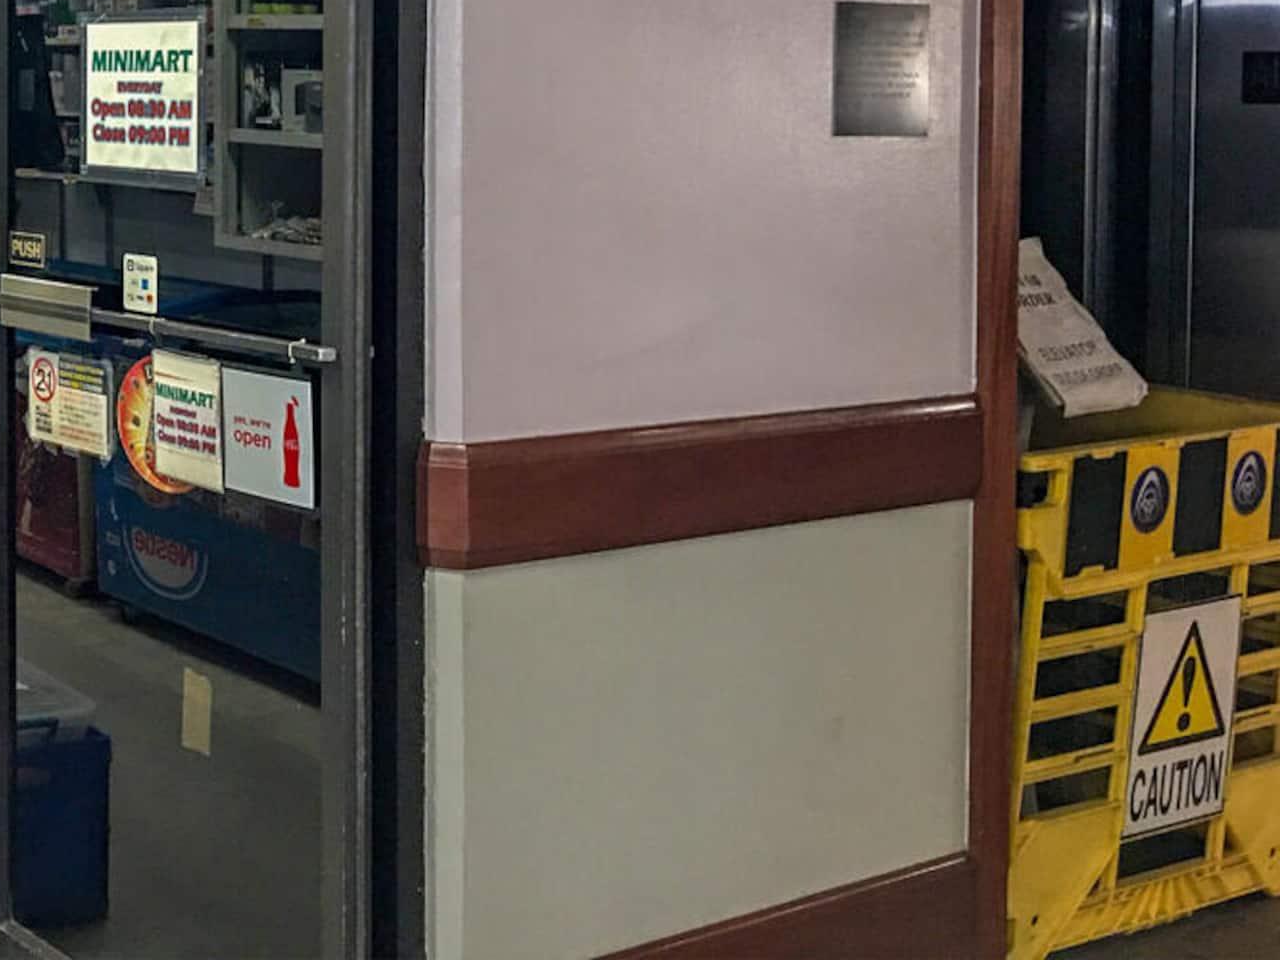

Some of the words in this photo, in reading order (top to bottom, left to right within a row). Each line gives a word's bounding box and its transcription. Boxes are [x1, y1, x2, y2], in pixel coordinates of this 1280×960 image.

[91, 49, 193, 73] MINIMART
[91, 98, 126, 121] Open
[168, 100, 192, 119] AM
[93, 123, 126, 144] Close
[169, 127, 190, 146] PM
[11, 240, 41, 260] PUSH
[36, 368, 52, 393] 21
[155, 382, 216, 410] MINIMART
[233, 429, 272, 450] open
[1130, 751, 1223, 822] CAUTION
